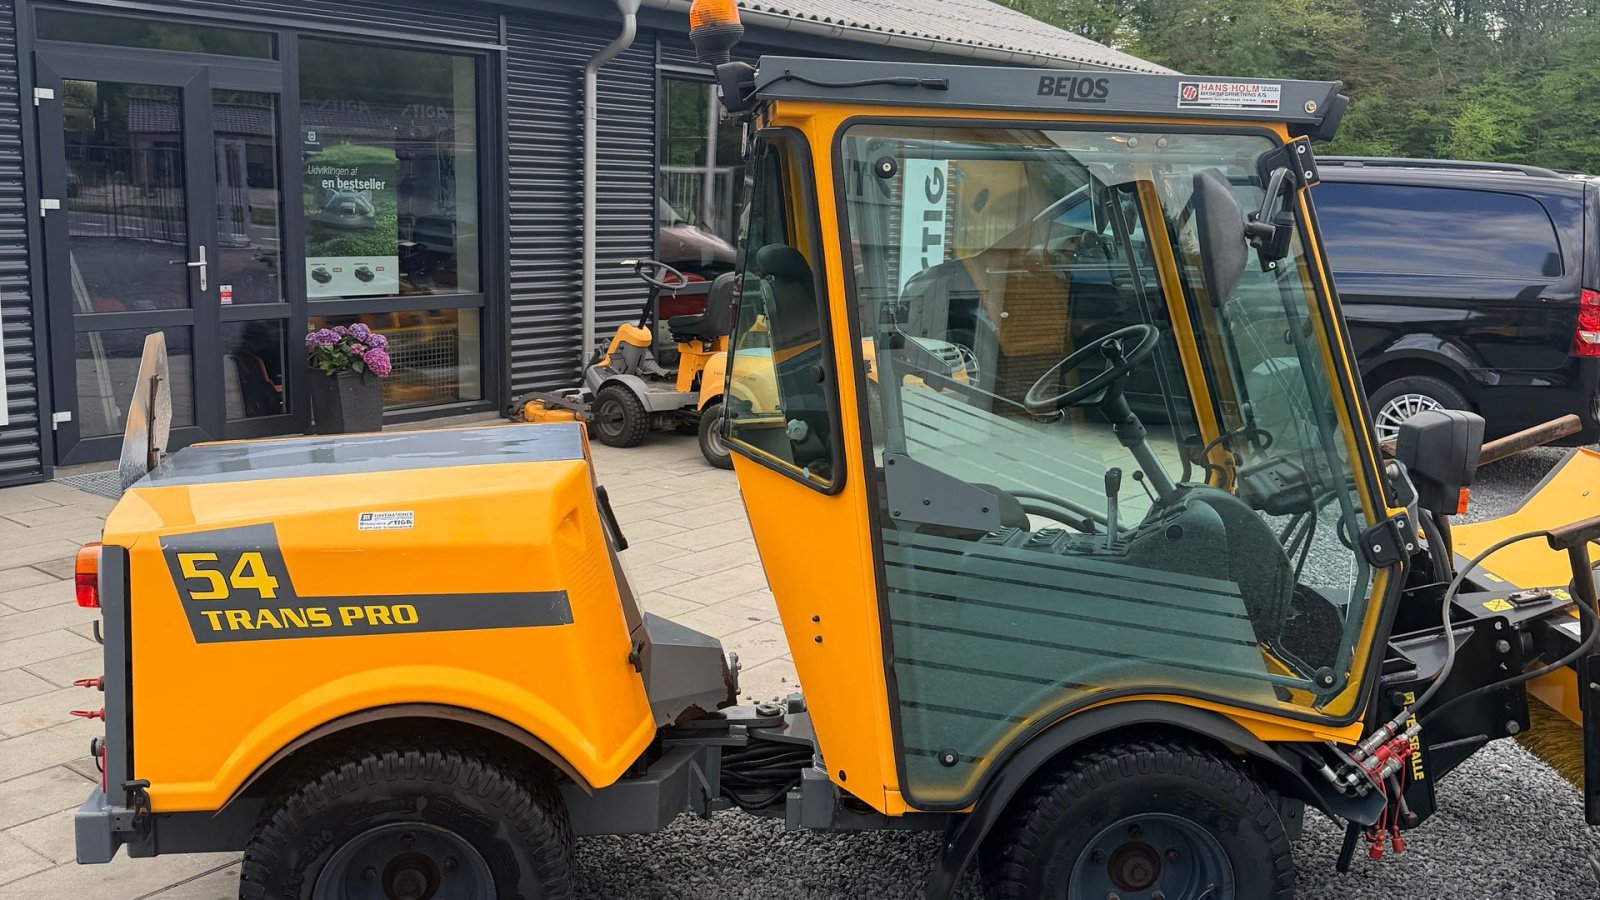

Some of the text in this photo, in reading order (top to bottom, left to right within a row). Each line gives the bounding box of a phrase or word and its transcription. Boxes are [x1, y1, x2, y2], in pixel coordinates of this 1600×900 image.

[1037, 76, 1109, 103] BELOS
[1200, 84, 1228, 92] HANS
[1231, 84, 1260, 93] HOLM
[401, 103, 448, 119] STIGA
[307, 165, 358, 177] Udviklingen af
[321, 177, 386, 190] en bestseller
[177, 552, 280, 600] 54
[200, 604, 419, 631] TRANS PRO
